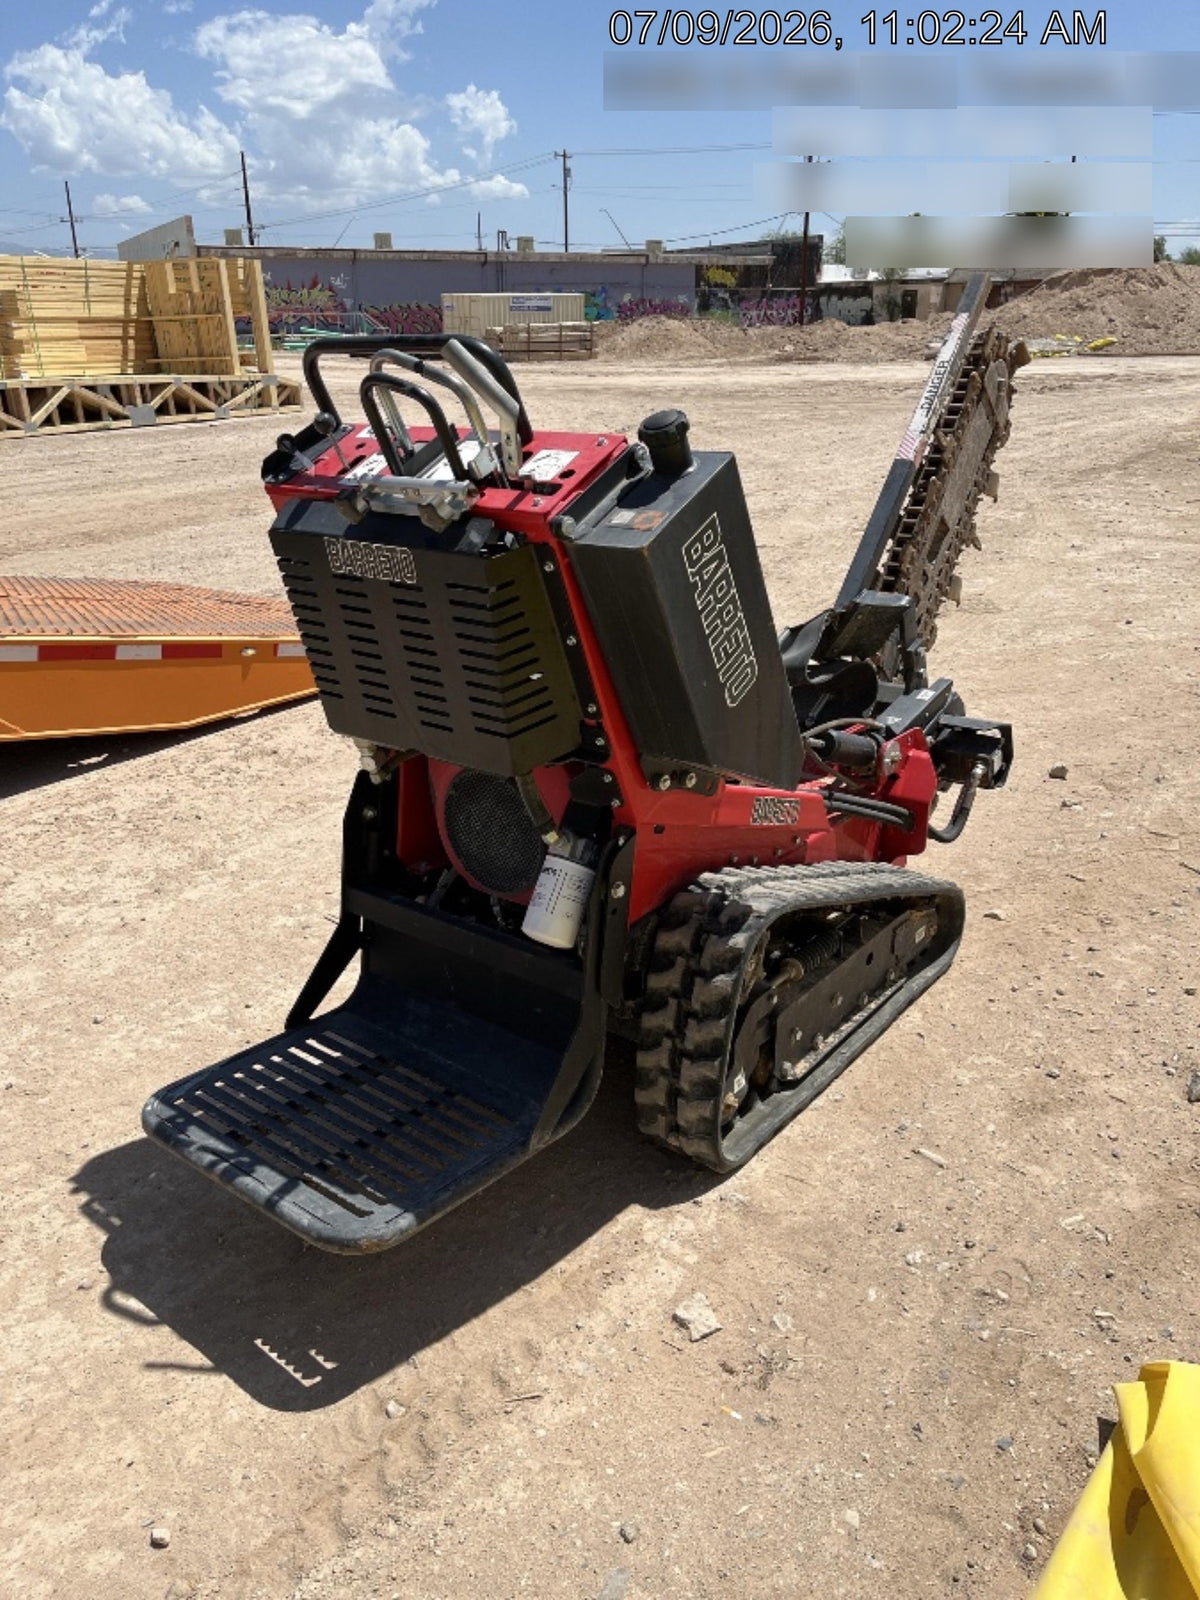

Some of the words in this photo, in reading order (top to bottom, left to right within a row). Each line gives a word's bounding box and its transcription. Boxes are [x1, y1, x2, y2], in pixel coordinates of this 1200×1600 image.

[920, 360, 950, 418] DANGER
[323, 536, 417, 584] BARRETO
[682, 511, 759, 707] BARRETO
